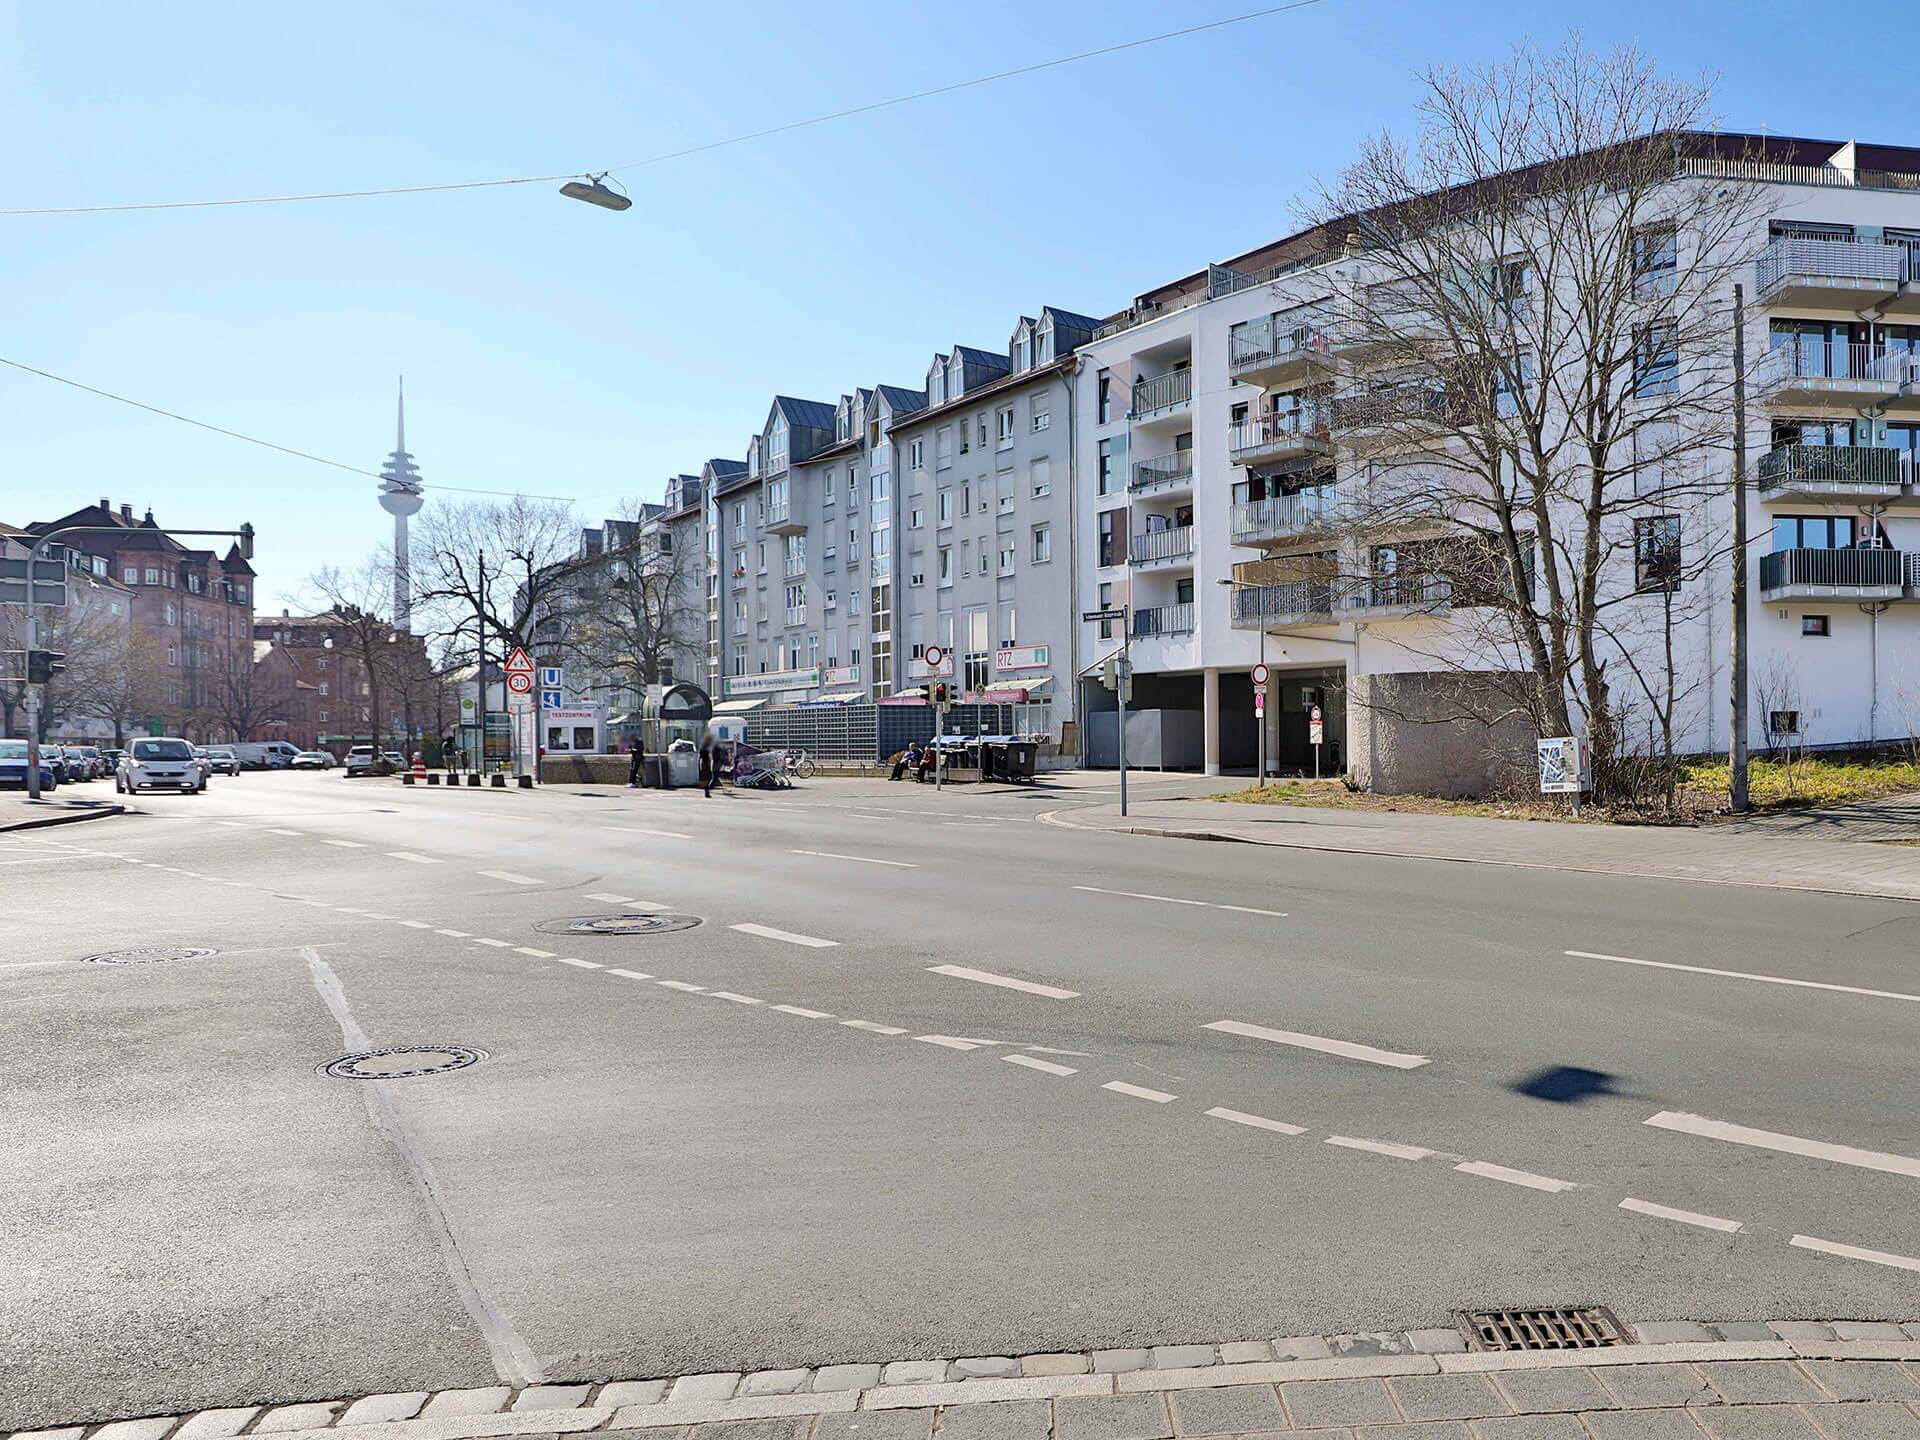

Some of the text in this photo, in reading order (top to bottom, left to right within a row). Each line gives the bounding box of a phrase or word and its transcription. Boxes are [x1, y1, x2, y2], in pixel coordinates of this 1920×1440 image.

[997, 651, 1012, 667] RTZ
[513, 678, 527, 688] 30
[545, 669, 559, 685] U
